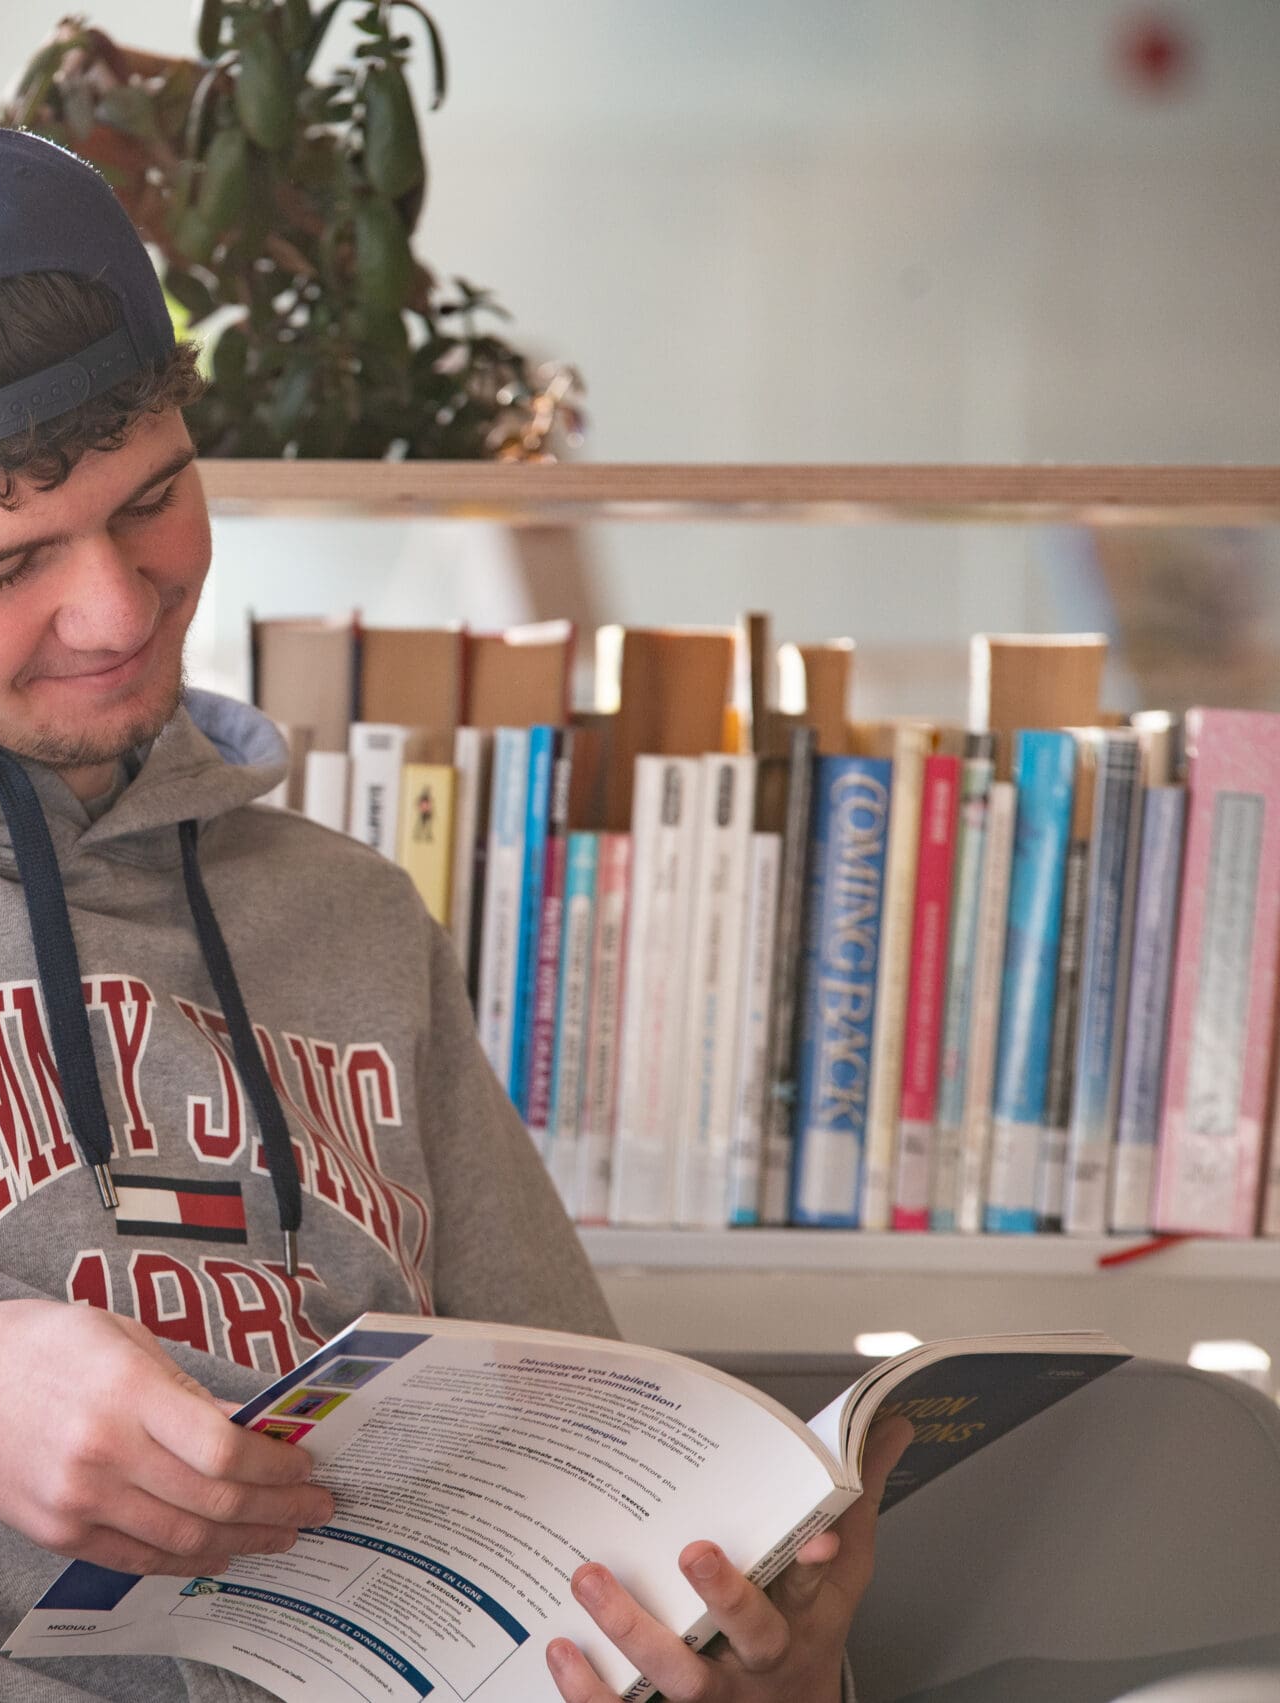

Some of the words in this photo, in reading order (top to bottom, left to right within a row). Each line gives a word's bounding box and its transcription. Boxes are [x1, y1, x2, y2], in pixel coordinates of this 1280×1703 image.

[829, 772, 888, 973] COMING
[818, 976, 874, 1130] BACK
[170, 995, 433, 1318] JNS
[497, 1364, 569, 1377] compétences
[588, 1377, 674, 1407] communication
[519, 1358, 585, 1372] Développez
[587, 1368, 607, 1376] vos
[608, 1371, 660, 1391] habiletés
[312, 1526, 366, 1544] DÉCOUVREZ
[367, 1540, 385, 1550] LES
[385, 1546, 441, 1574] RESSOURCES
[456, 1580, 483, 1601] LIGNE
[568, 1544, 590, 1564] rattac
[241, 1590, 311, 1613] APPRENTISSAGE
[312, 1611, 339, 1624] ACTIF
[426, 1579, 472, 1612] ENSEIGNANTS
